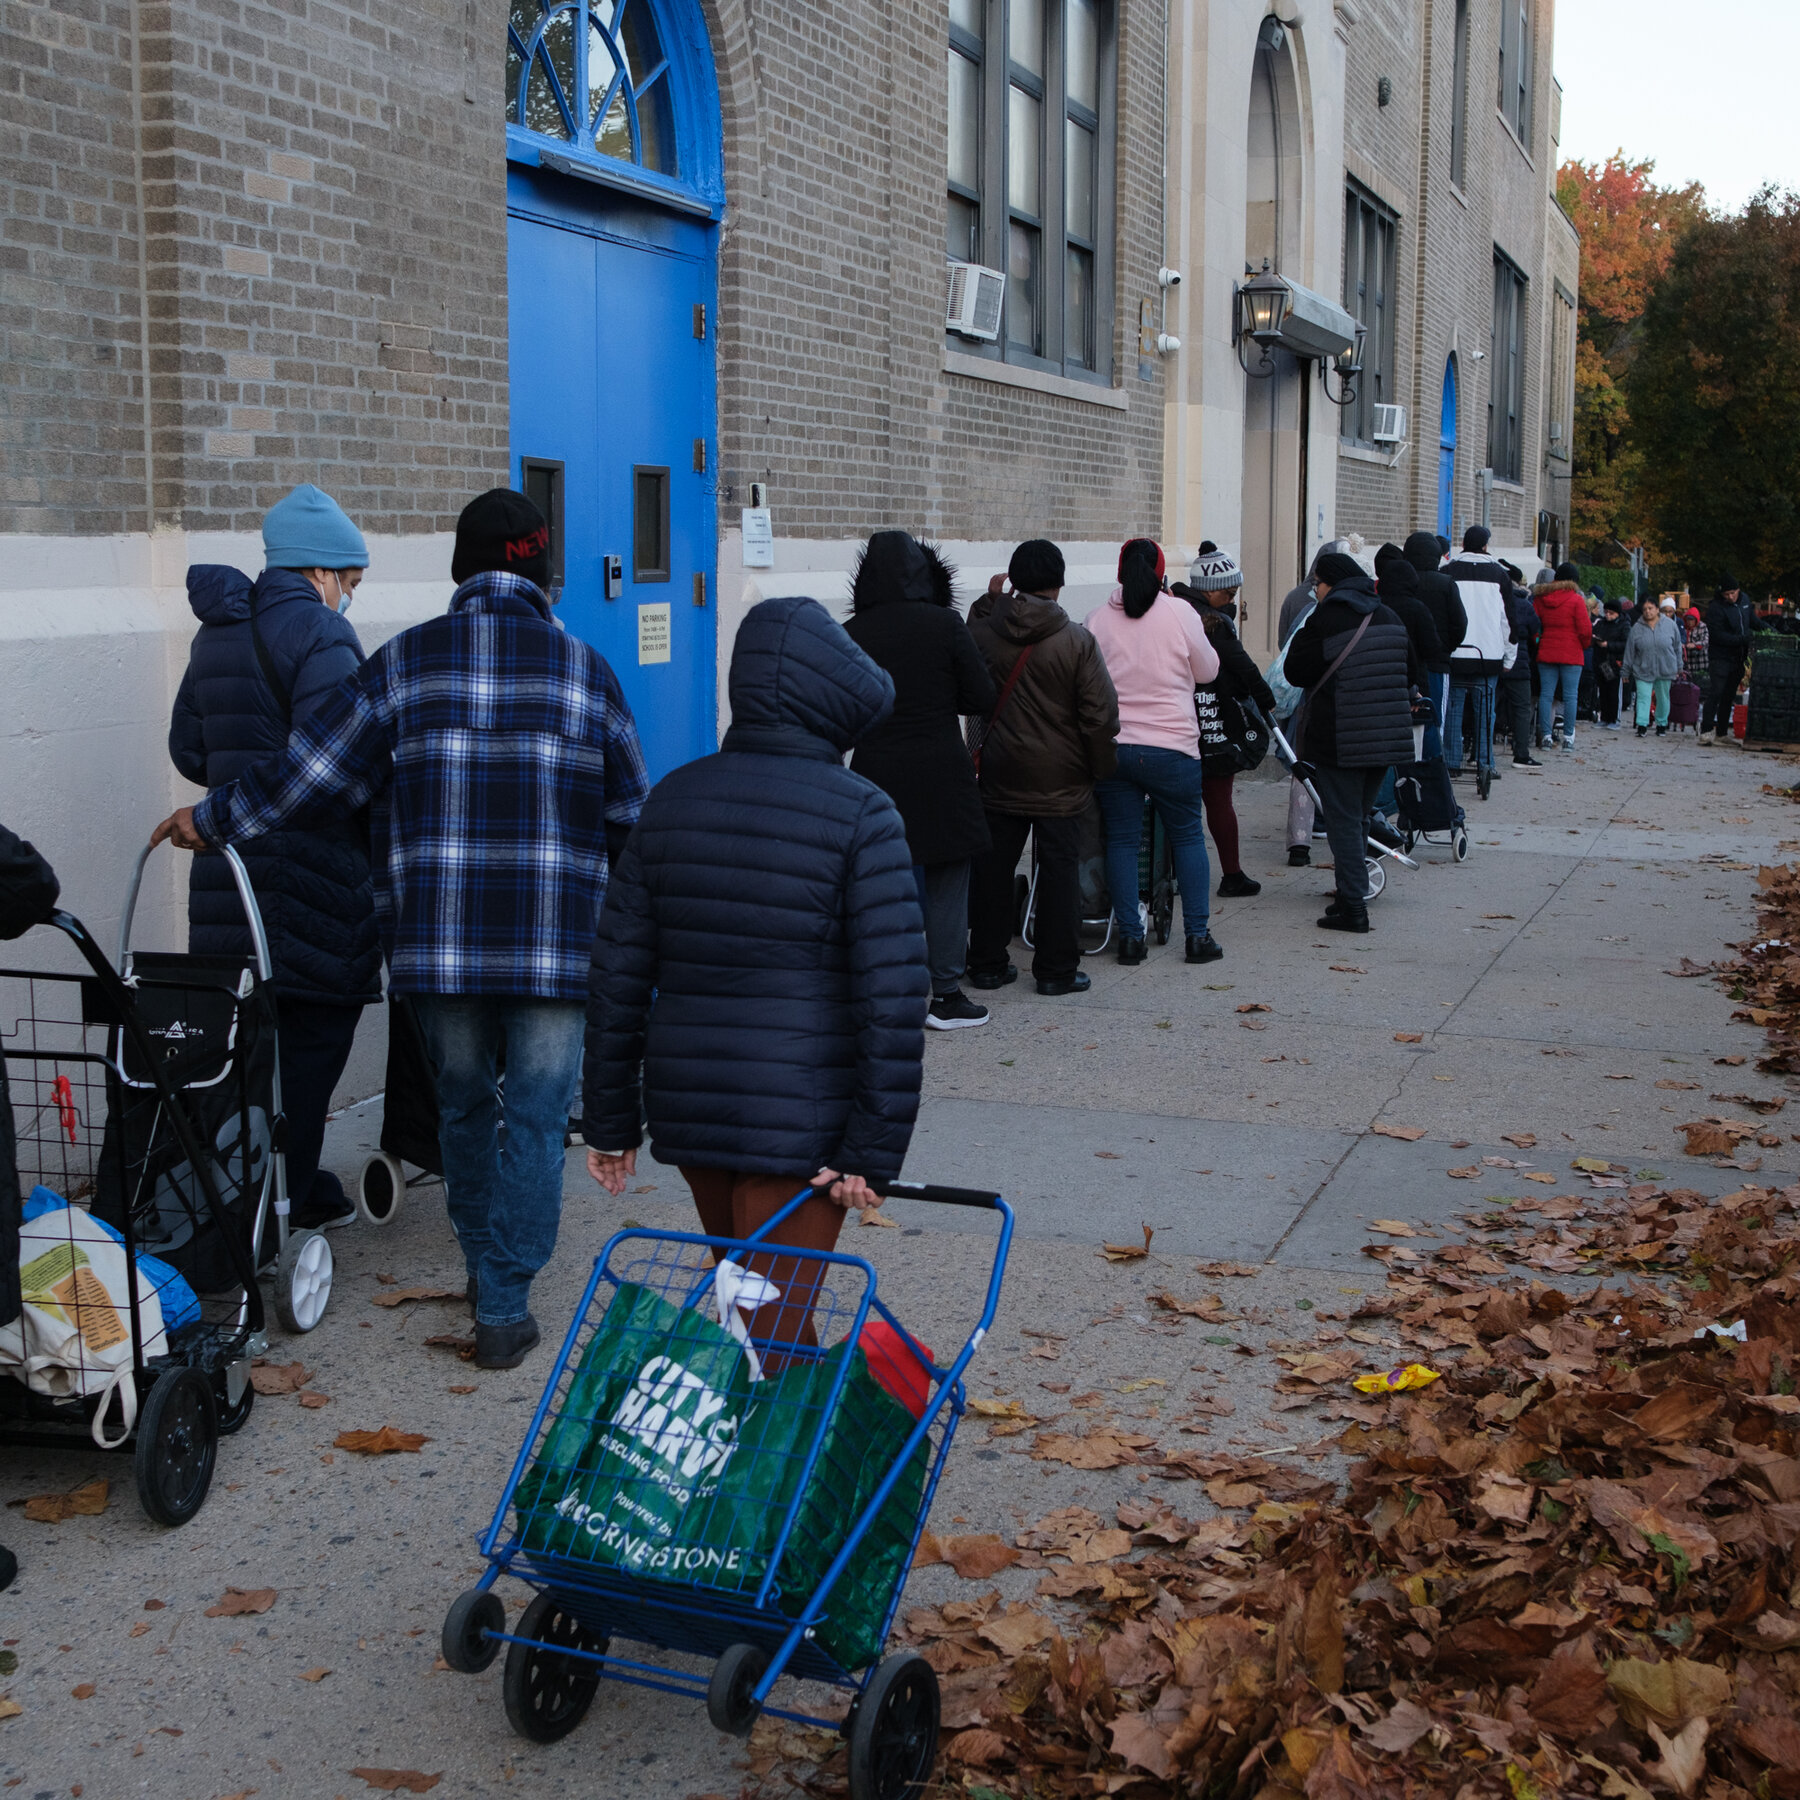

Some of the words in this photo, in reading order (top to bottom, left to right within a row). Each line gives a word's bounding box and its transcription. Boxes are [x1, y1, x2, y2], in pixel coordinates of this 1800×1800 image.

[638, 1355, 727, 1428] CITY
[610, 1388, 739, 1479] HARV
[650, 1468, 690, 1503] FOOD
[572, 1503, 743, 1571] CORNESTONE
